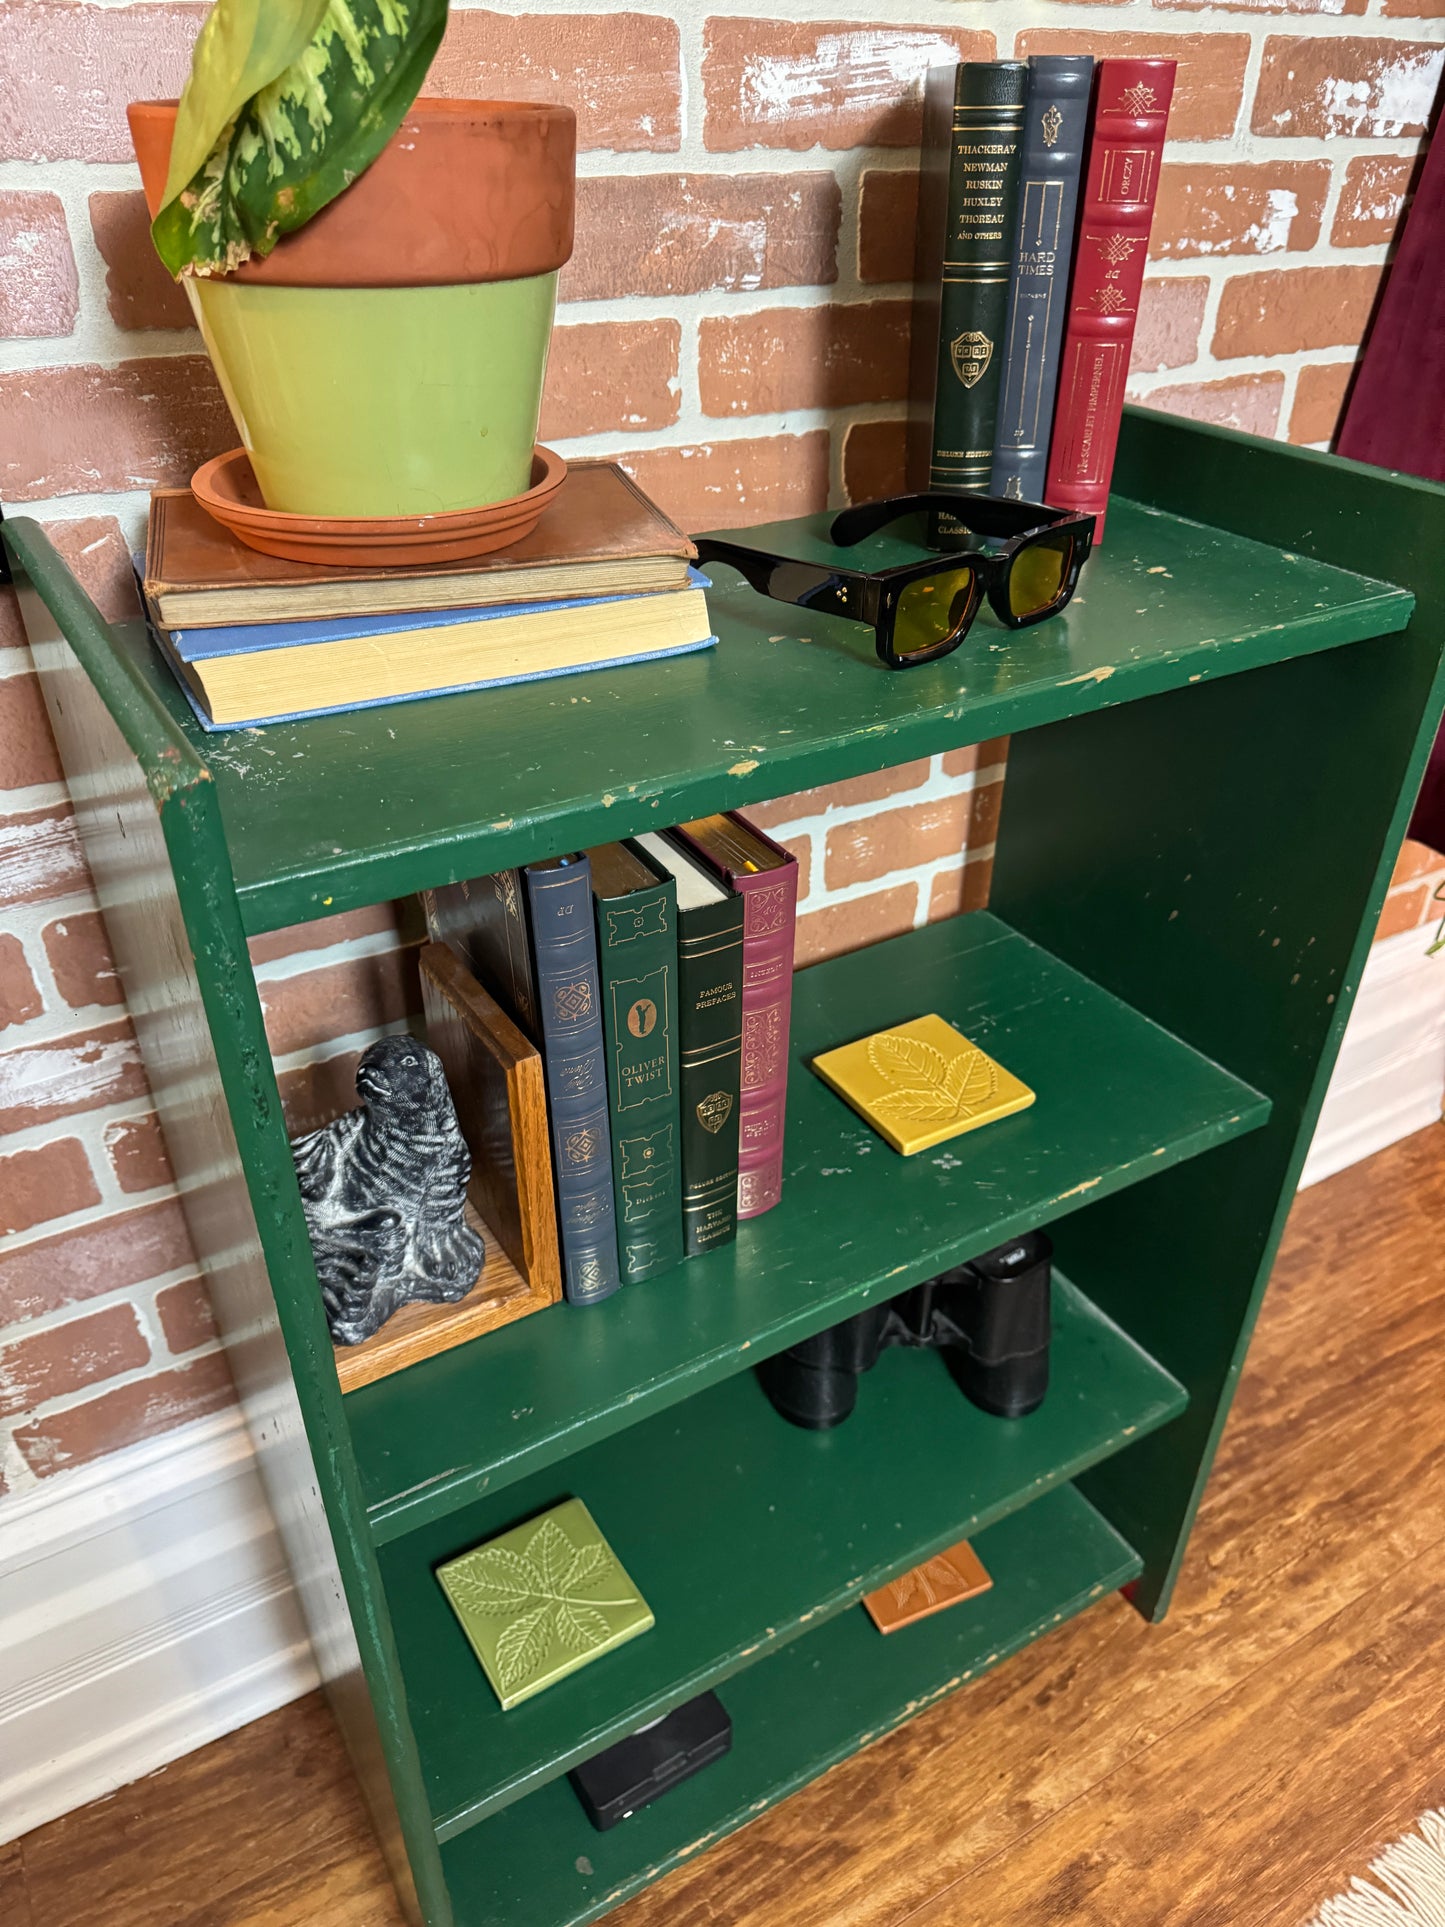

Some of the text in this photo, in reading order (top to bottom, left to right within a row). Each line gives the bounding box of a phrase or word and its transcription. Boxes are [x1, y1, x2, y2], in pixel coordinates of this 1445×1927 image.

[957, 144, 1017, 155] THACKERAY
[963, 162, 1008, 172] NEWMAN
[1120, 157, 1133, 195] ORCZY
[965, 179, 1004, 190] RUSKIN
[962, 197, 1004, 207] HUXLEY
[959, 213, 1004, 224] THOREAU
[957, 231, 1002, 240] AND OTHERS
[1019, 251, 1056, 263] HARD
[1018, 264, 1054, 276] TIMES
[698, 981, 733, 999] FAMOUS
[695, 990, 737, 1010] PREFACES
[621, 1055, 666, 1077] OLIVER
[625, 1068, 663, 1088] TWIST
[706, 1208, 723, 1220] THE
